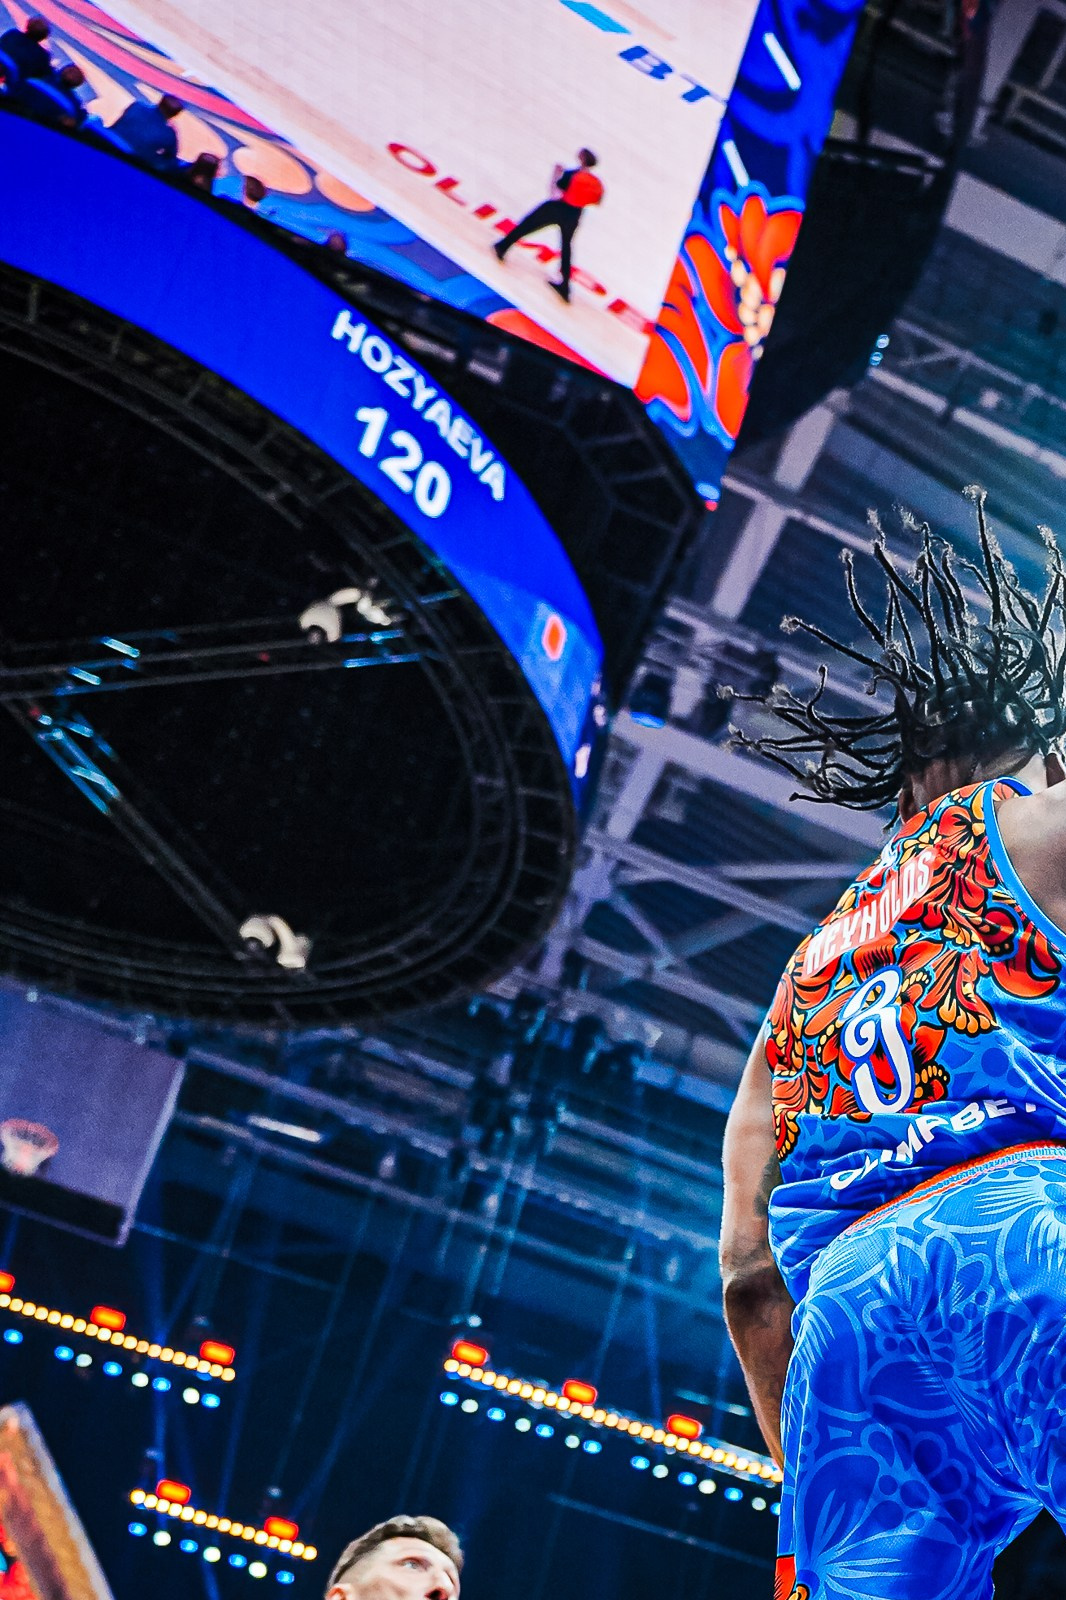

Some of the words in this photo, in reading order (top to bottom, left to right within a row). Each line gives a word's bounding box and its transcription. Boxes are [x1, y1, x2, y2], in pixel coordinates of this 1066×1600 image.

[330, 309, 506, 502] HOZYAEVA
[355, 406, 452, 518] 120
[806, 850, 934, 976] REYNOLDS
[829, 1098, 1037, 1190] OLIMPBE
